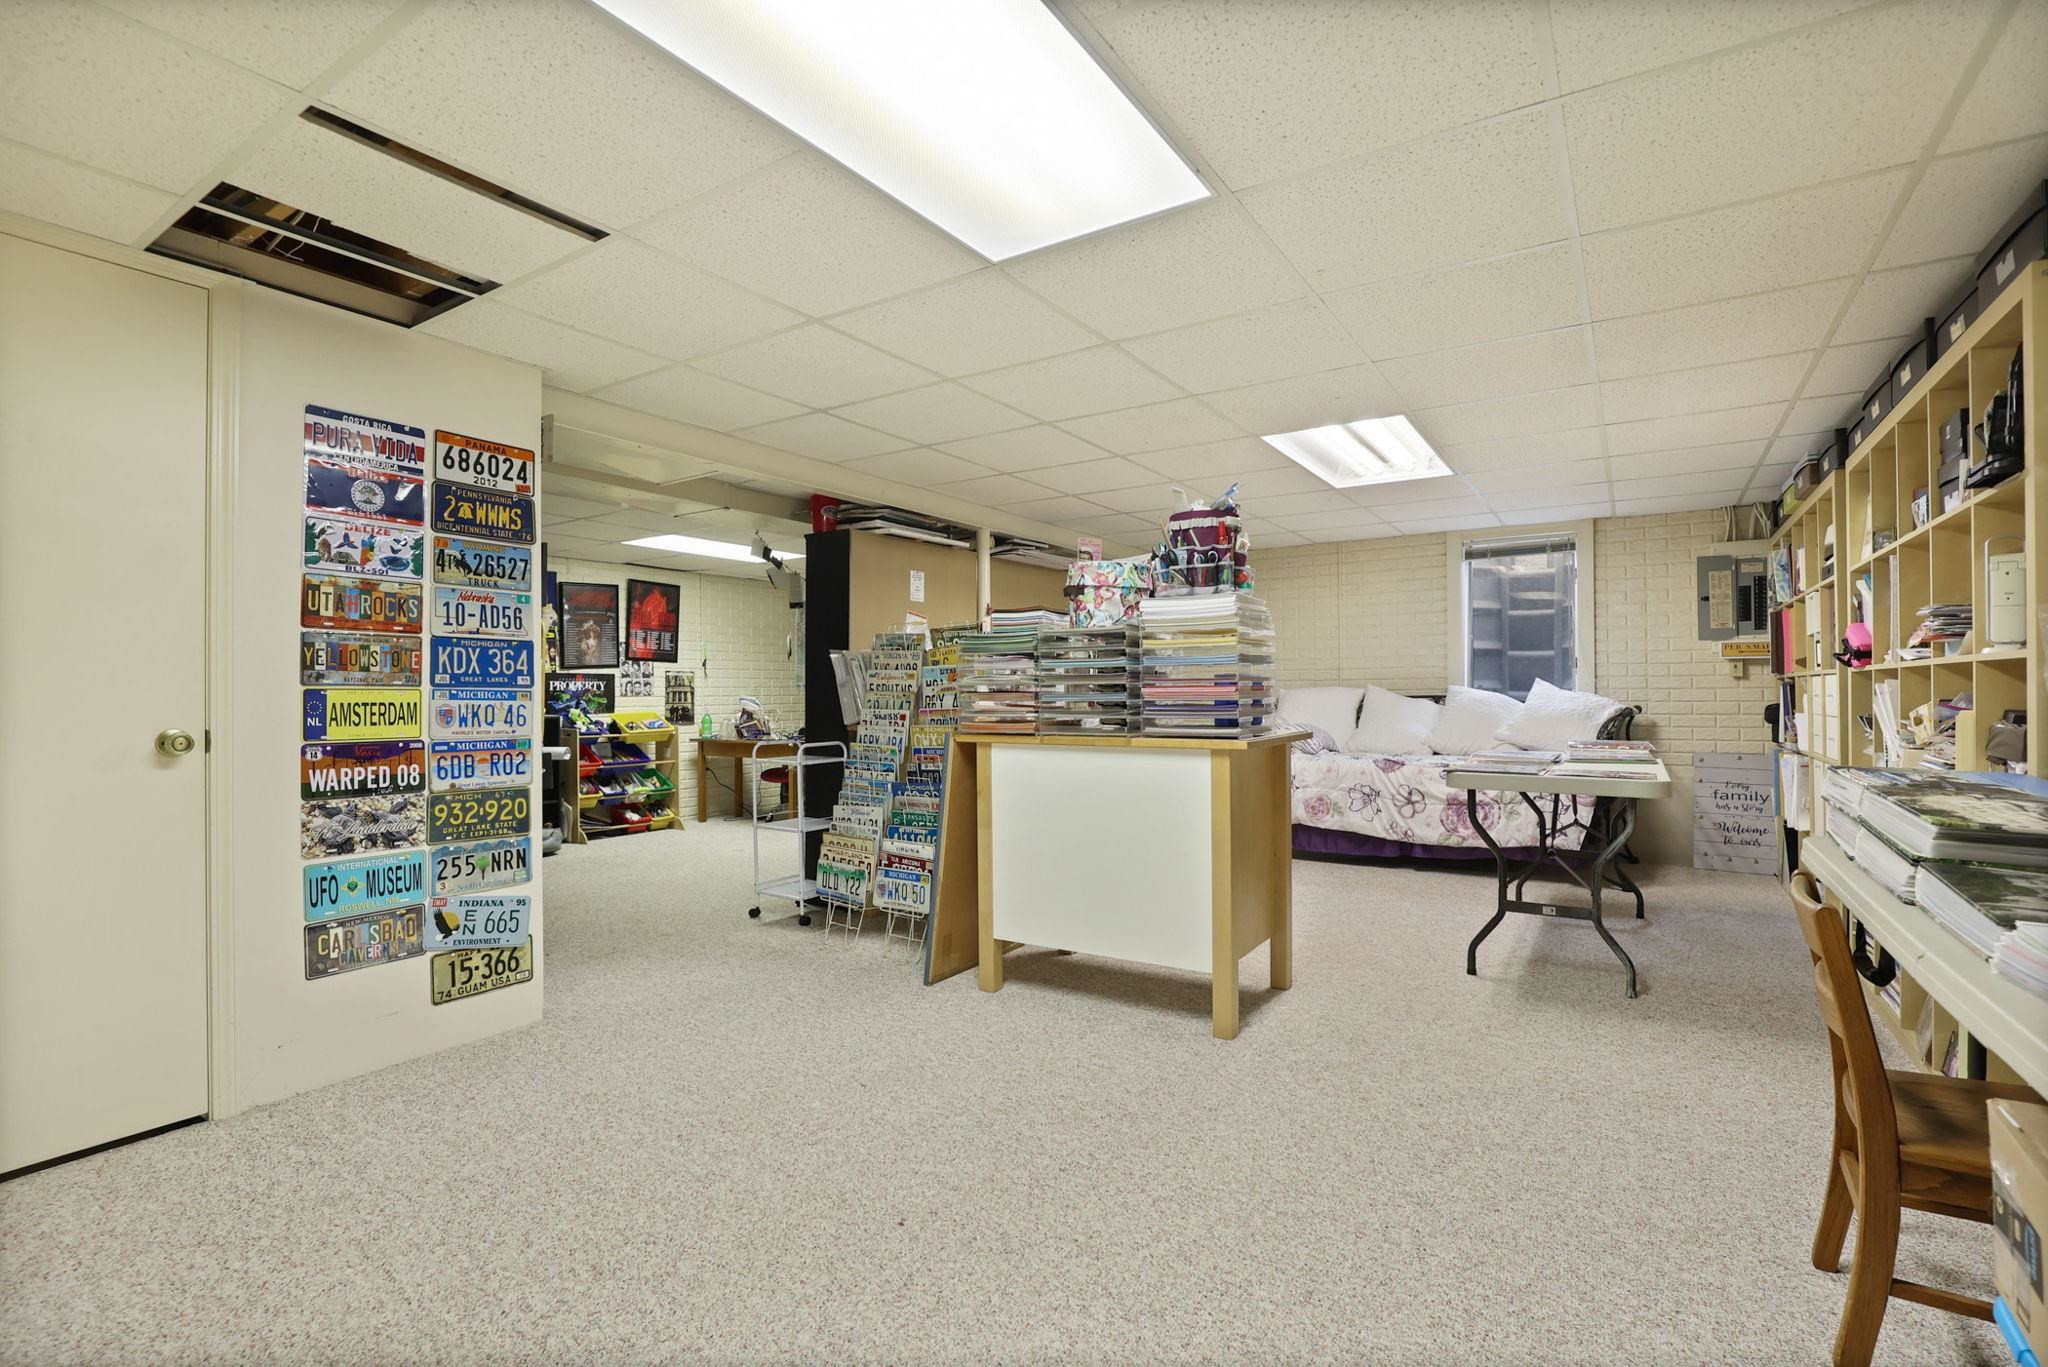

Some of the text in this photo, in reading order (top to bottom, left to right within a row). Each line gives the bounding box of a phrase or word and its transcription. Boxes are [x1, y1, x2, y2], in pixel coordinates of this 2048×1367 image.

[342, 415, 392, 432] COSTA RICA
[312, 421, 418, 465] PURA VIDA
[465, 440, 507, 455] PANAMA
[442, 445, 528, 484] 686024
[473, 476, 498, 487] 2012
[457, 488, 512, 504] PENNSYLVANIA
[443, 495, 522, 530] 2 WWMS
[344, 523, 391, 536] BELIZE
[437, 521, 490, 536] BICENTENNIAL
[493, 529, 513, 538] STATE
[472, 553, 529, 581] 26527
[467, 578, 499, 588] TRUCK
[457, 591, 495, 604] Nebraska
[442, 601, 523, 631] 10-AD56
[461, 640, 508, 648] MICHIGAN
[303, 646, 420, 669] YELLOWSTONE
[438, 646, 529, 675] KDX 364
[549, 680, 607, 691] PROPERTY
[457, 690, 509, 699] MICHIGAN
[307, 702, 418, 727] NL AMSTERDAM
[458, 704, 527, 728] WKQ 46
[456, 741, 508, 751] MICHIGAN
[310, 751, 318, 759] 14
[436, 754, 475, 780] 6DB
[308, 764, 420, 793] WARPED 08
[455, 793, 482, 801] MICH
[1713, 789, 1770, 805] family
[1715, 802, 1731, 811] has
[443, 826, 468, 834] GREAT
[471, 823, 491, 831] LAKE
[1713, 820, 1770, 836] Welcome
[831, 848, 863, 859] MARYLAND
[337, 857, 398, 872] INTERNATIONAL
[437, 854, 476, 882] 255
[491, 847, 527, 873] NRN
[888, 870, 917, 881] MICHIGAN
[309, 862, 422, 908] UFO MUSEUM
[439, 882, 446, 891] 3
[887, 880, 926, 905] WKQ 50
[458, 898, 505, 908] INDIANA
[484, 909, 520, 935] 665
[317, 915, 416, 956] CARLSBAD
[453, 937, 502, 946] ENVIRONMENT
[339, 941, 399, 966] CAVERNS
[437, 974, 511, 1001] 74 GUAM USA
